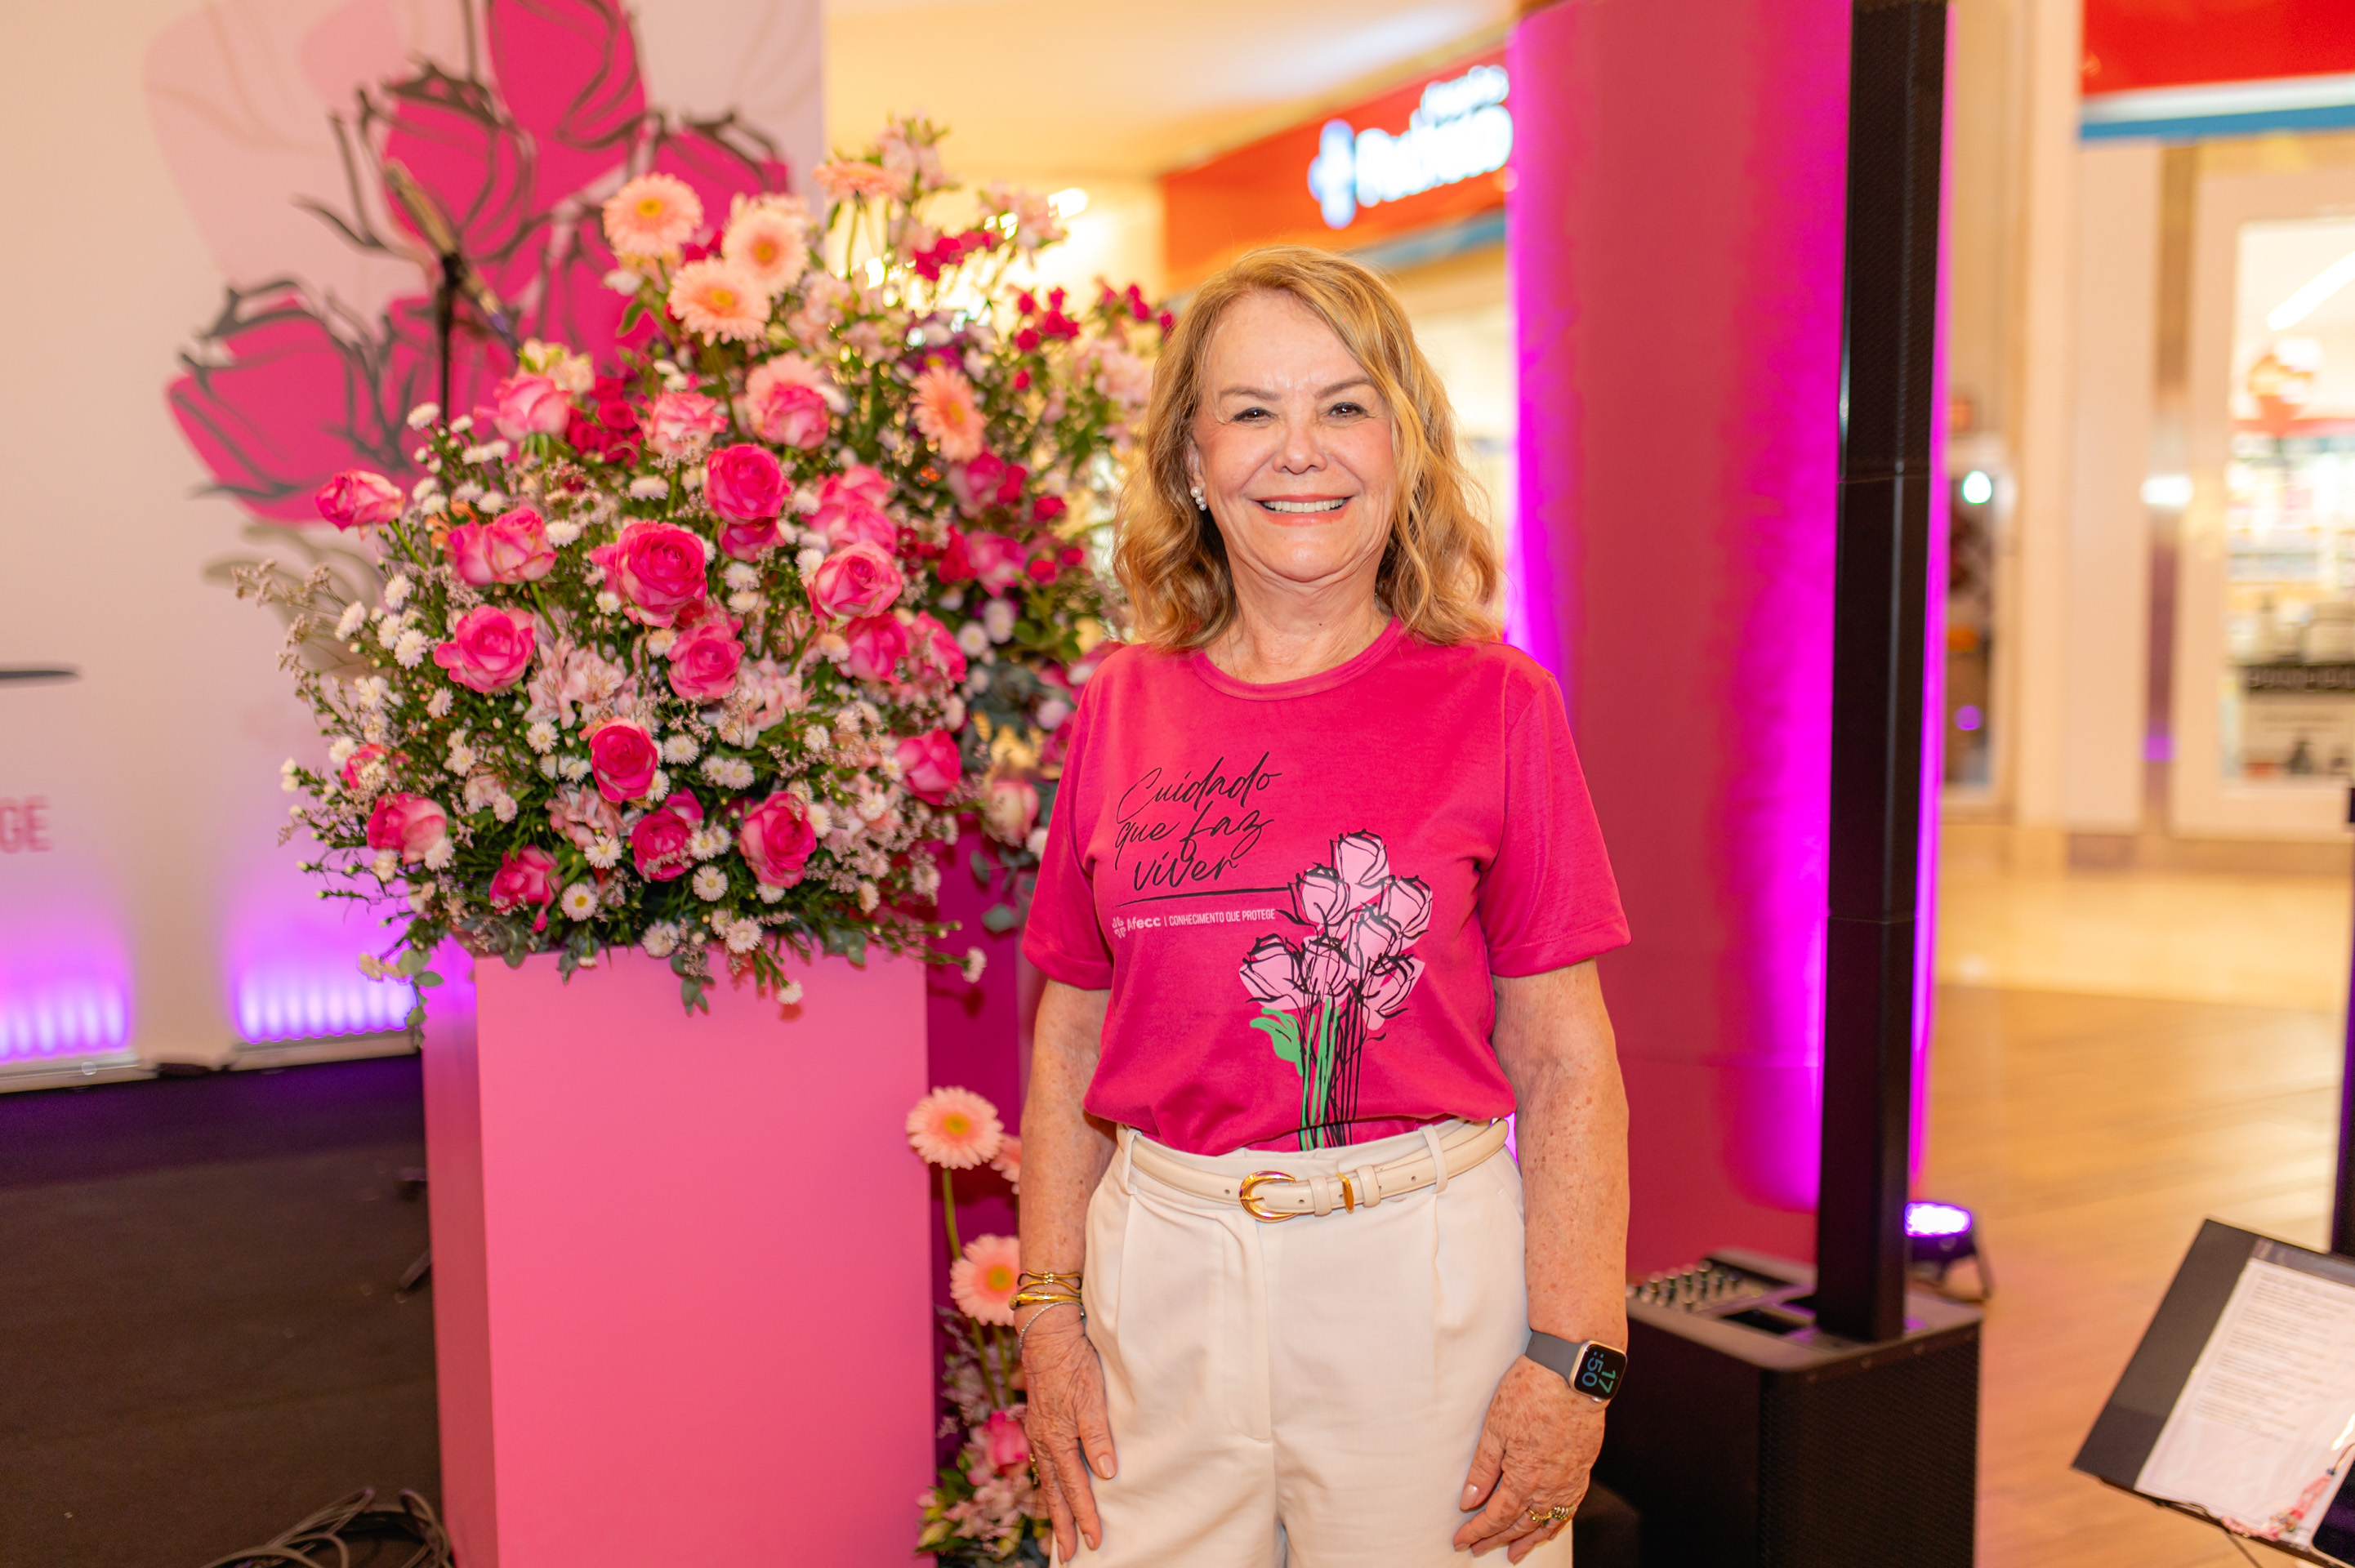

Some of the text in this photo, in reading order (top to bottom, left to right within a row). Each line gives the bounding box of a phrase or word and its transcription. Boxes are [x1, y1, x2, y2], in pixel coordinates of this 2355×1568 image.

[1117, 751, 1282, 824] Cuidado
[1115, 800, 1274, 871] que faz
[1134, 851, 1238, 891] viver
[1126, 908, 1275, 932] Afecc CONHECIMENTO QUE PROTEGE
[1599, 1370, 1617, 1393] 17
